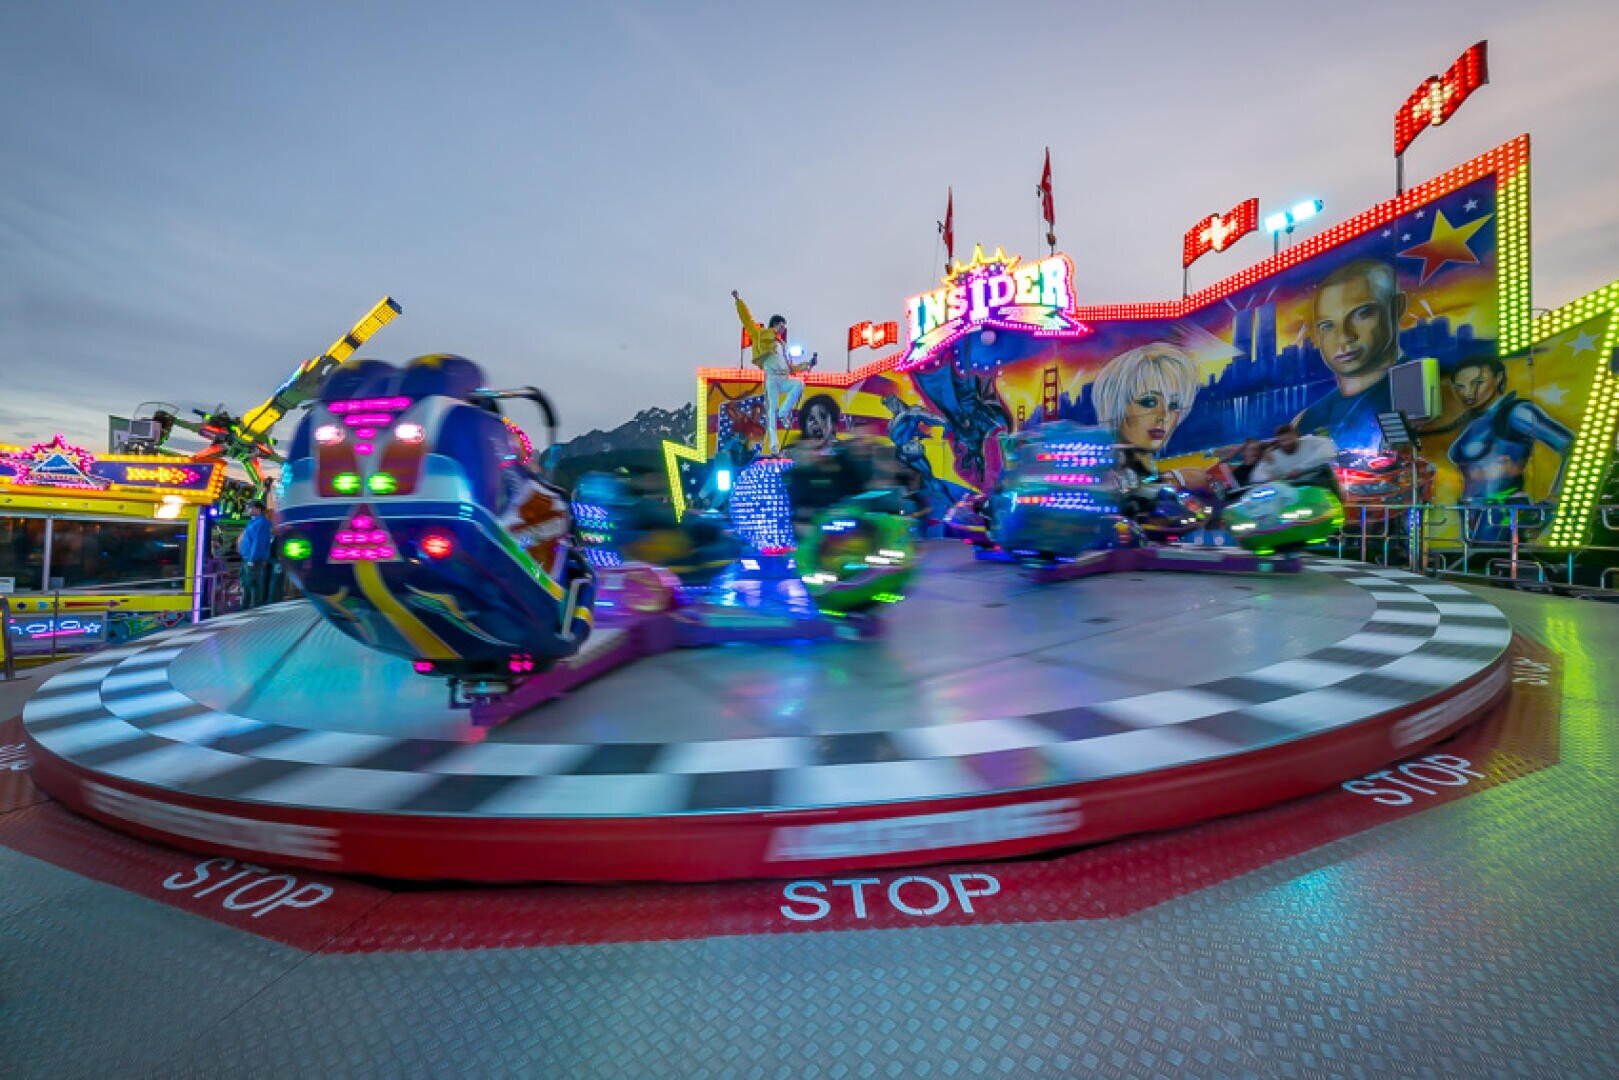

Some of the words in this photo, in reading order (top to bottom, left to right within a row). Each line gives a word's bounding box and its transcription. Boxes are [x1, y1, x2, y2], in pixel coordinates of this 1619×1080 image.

[906, 257, 1070, 344] INSIDER
[1342, 753, 1486, 806] STOP
[163, 857, 334, 919] STOP
[781, 873, 1000, 921] STOP
